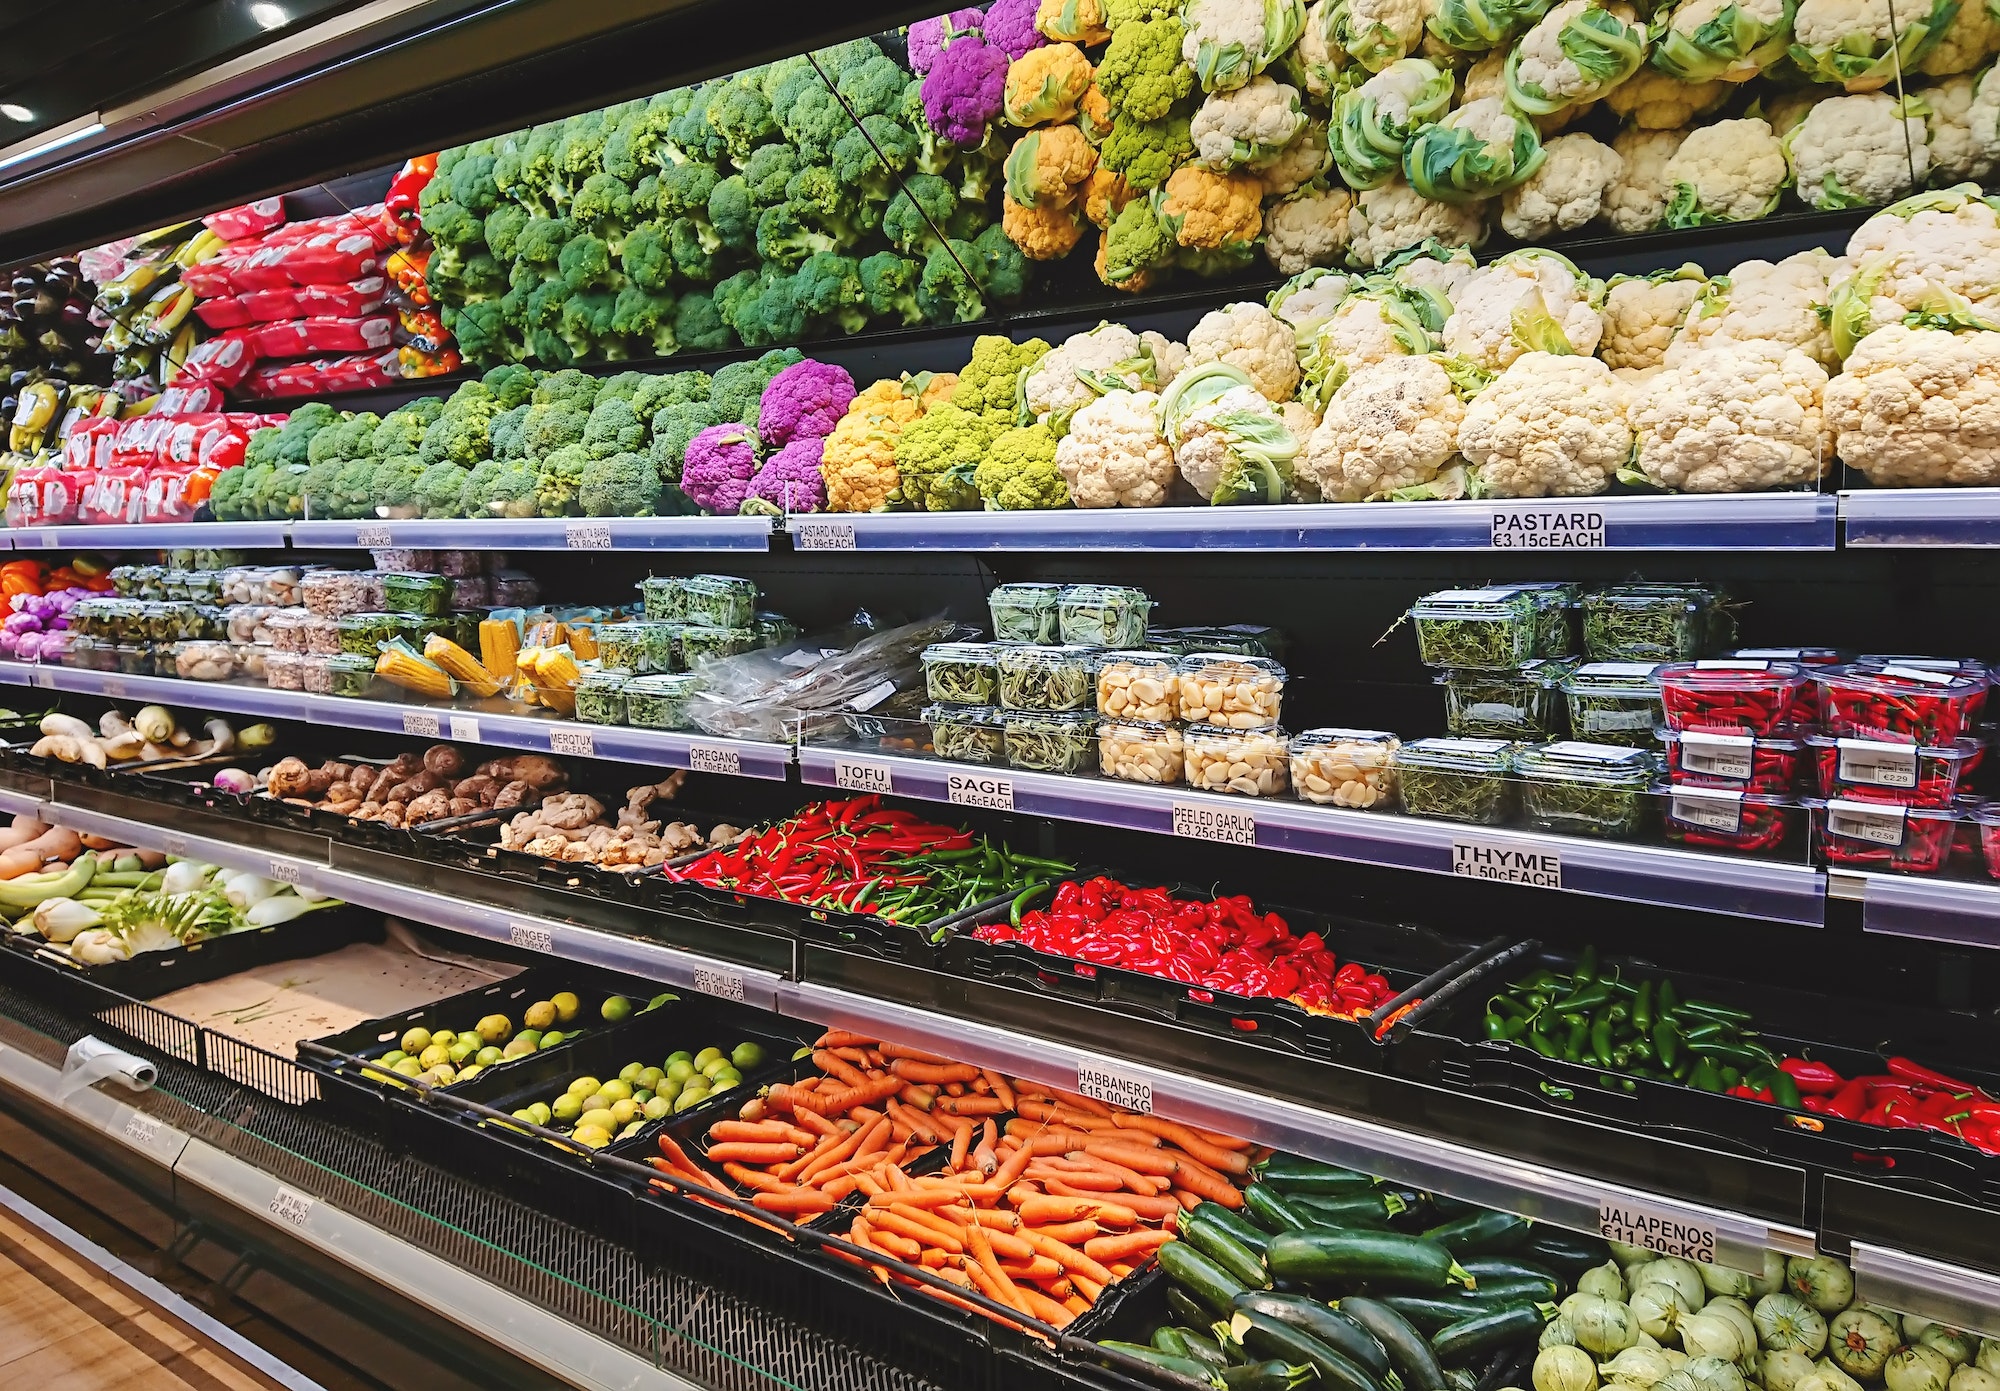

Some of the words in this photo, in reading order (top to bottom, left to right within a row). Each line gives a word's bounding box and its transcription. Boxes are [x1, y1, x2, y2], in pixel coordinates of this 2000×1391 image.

[1493, 513, 1602, 530] PASTARD
[594, 528, 609, 538] BARRA
[800, 525, 829, 537] PASTARD
[831, 525, 853, 537] KULUR
[359, 537, 391, 547] €3.80cKG
[569, 538, 611, 548] €3.80cKG
[802, 538, 854, 548] €3.99cEACH
[1493, 533, 1602, 547] €3.15cEACH
[404, 715, 423, 726] COOKED
[424, 717, 438, 728] CORN
[551, 733, 591, 746] MERQTUX
[552, 744, 592, 756] €1.48cEACH
[691, 748, 739, 764] OREGANO
[693, 760, 740, 774] €1.50cEACH
[842, 765, 884, 782] TOFU
[1721, 766, 1744, 775] €2.59
[839, 777, 891, 793] €2.40cEACH
[1883, 774, 1908, 782] €2.29
[950, 777, 1010, 796] SAGE
[952, 792, 1012, 809] €1.45cEACH
[1175, 807, 1213, 826] PEELED
[1216, 814, 1254, 832] GARLIC
[1177, 823, 1254, 844] €3.25cEACH
[1870, 831, 1895, 840] €2.59
[1454, 844, 1558, 873] THYME
[271, 863, 298, 877] TARO
[1455, 862, 1559, 887] €1.50cEACH
[511, 926, 551, 943] GINGER
[513, 936, 552, 952] €3.99cKG
[695, 969, 710, 981] RED
[711, 972, 742, 990] CHILLIES
[695, 980, 743, 1000] €10.00cKG
[1079, 1067, 1151, 1098] HABBANERO
[1080, 1083, 1151, 1112] €15.00cKG
[1601, 1206, 1714, 1248] JALAPENOS
[1601, 1224, 1713, 1263] €11.50cKG
